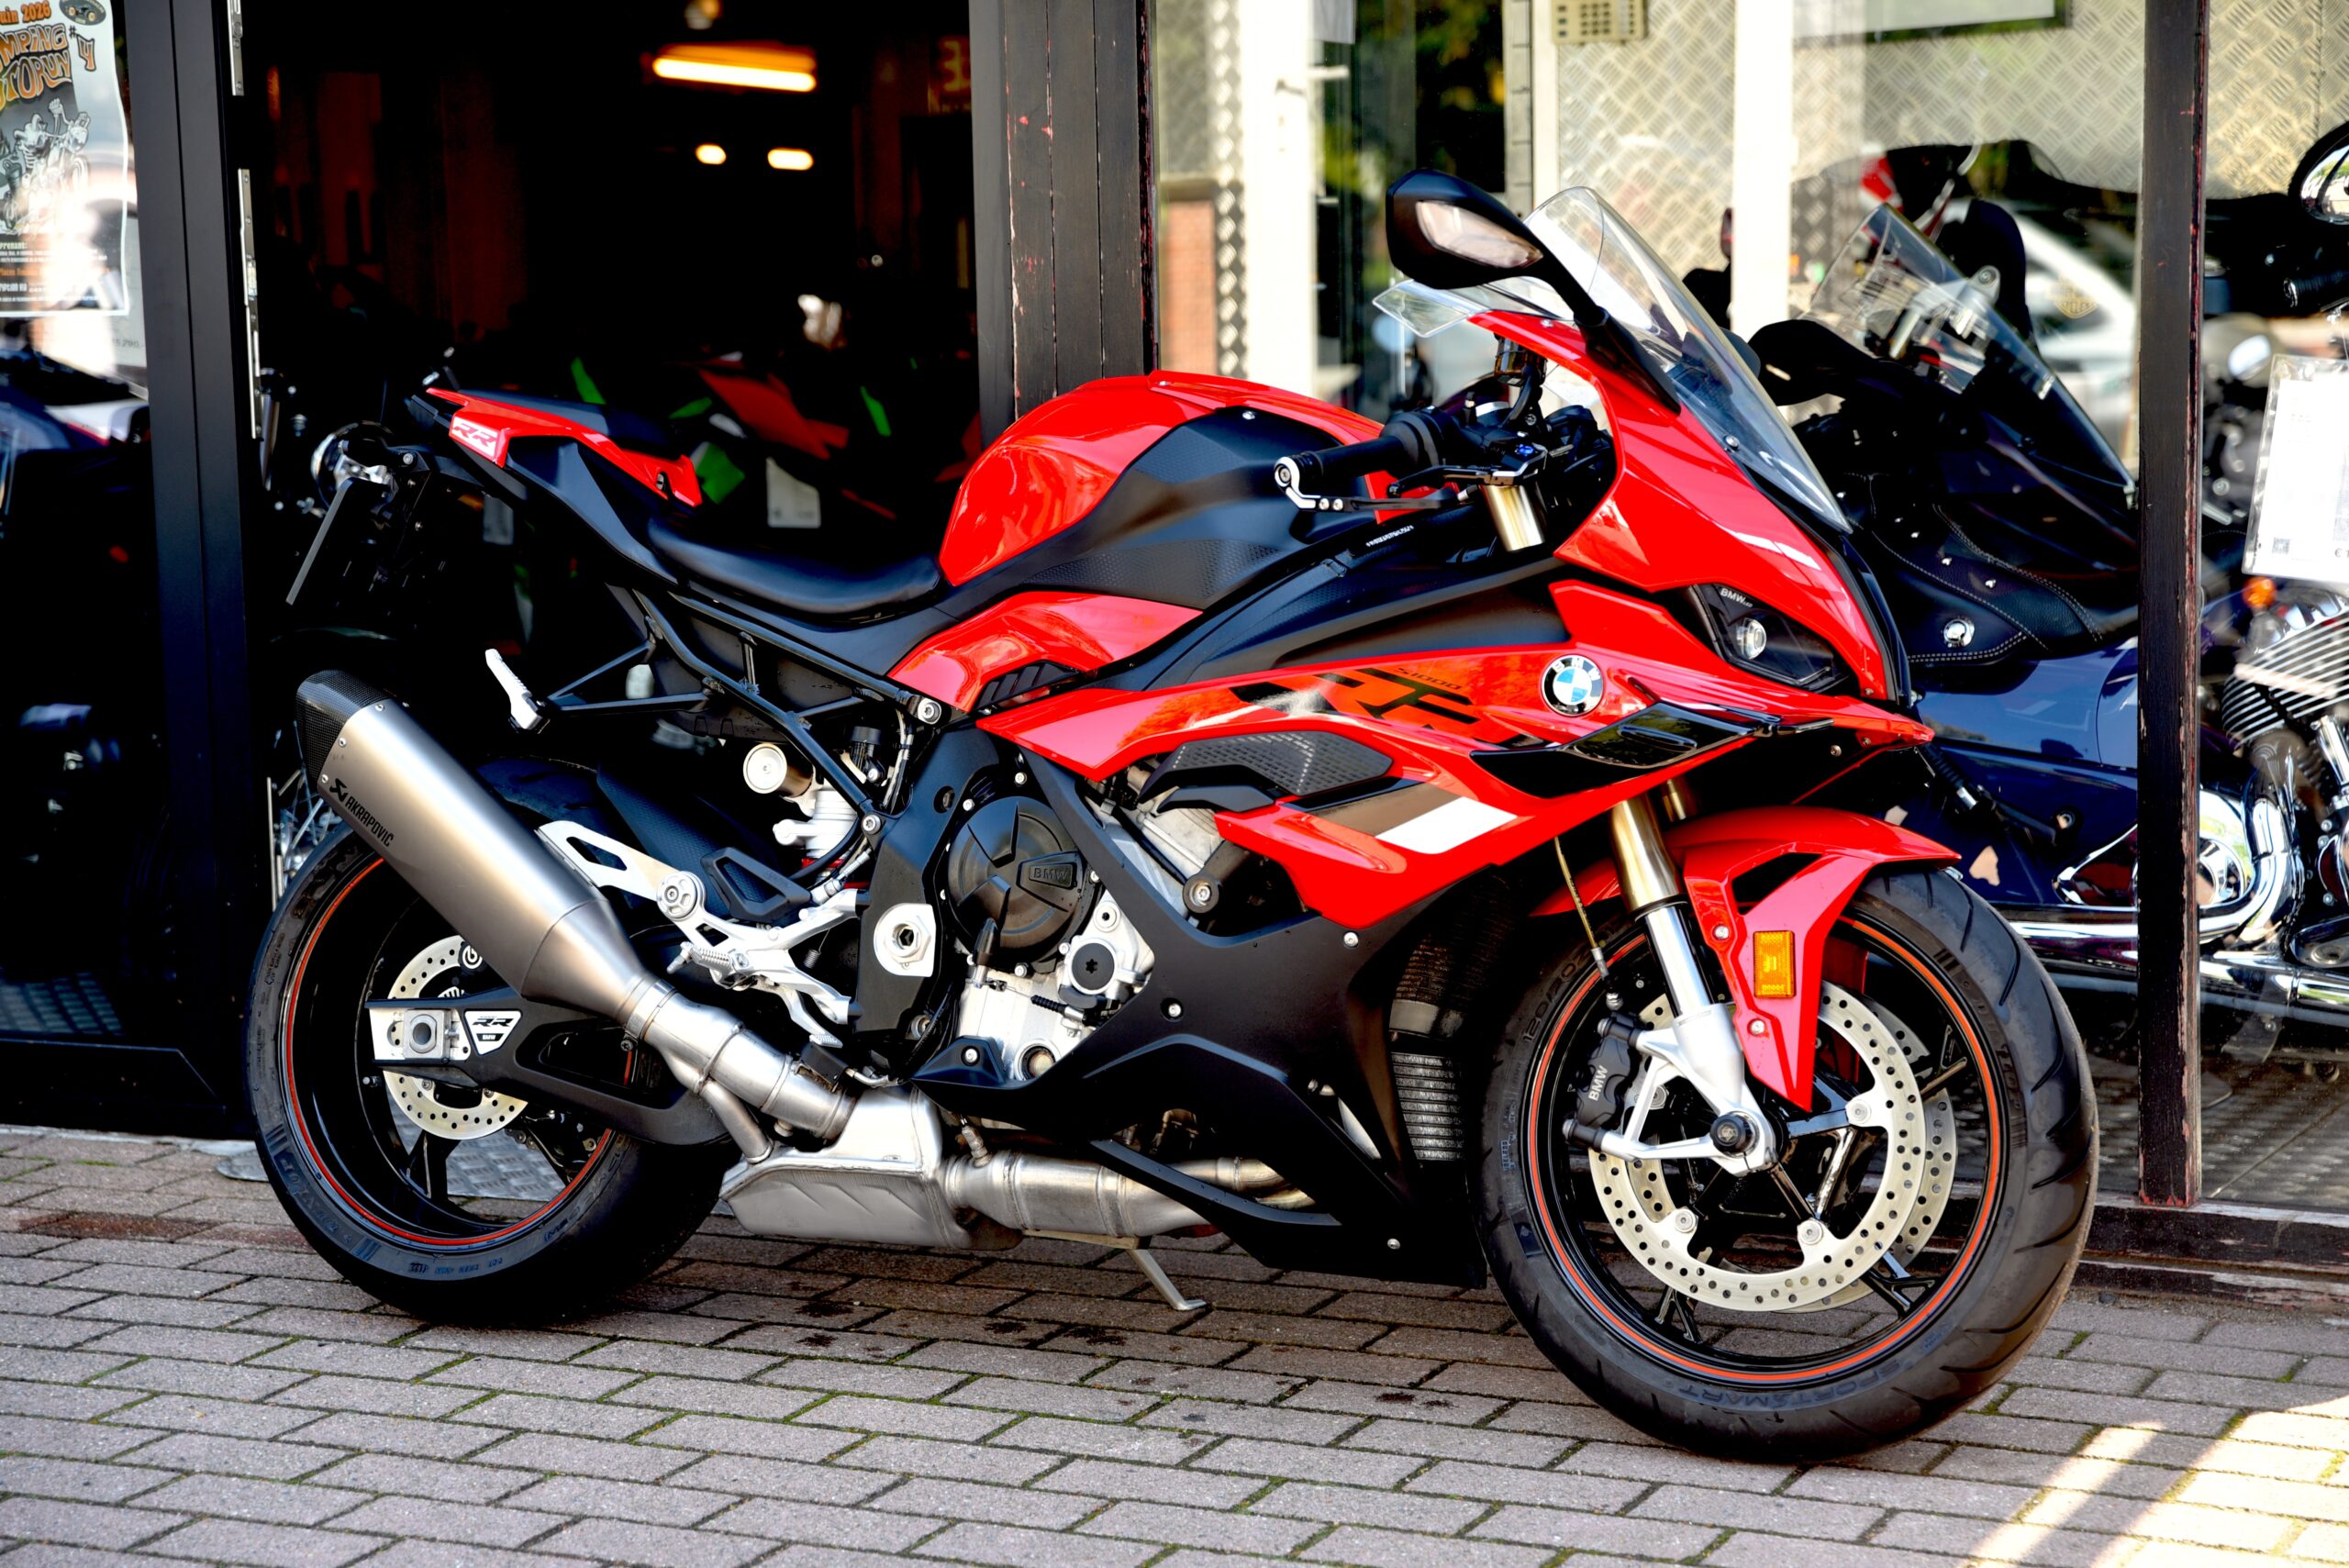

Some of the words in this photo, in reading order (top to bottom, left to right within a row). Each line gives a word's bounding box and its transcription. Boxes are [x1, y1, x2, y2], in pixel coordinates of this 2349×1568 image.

[0, 6, 18, 25] uin
[21, 2, 51, 23] 2026
[453, 423, 497, 447] RR
[1720, 587, 1746, 605] BMW
[1552, 657, 1602, 682] BMW
[1033, 867, 1068, 883] BMW
[472, 1018, 514, 1028] RR
[1587, 1064, 1609, 1102] BMW
